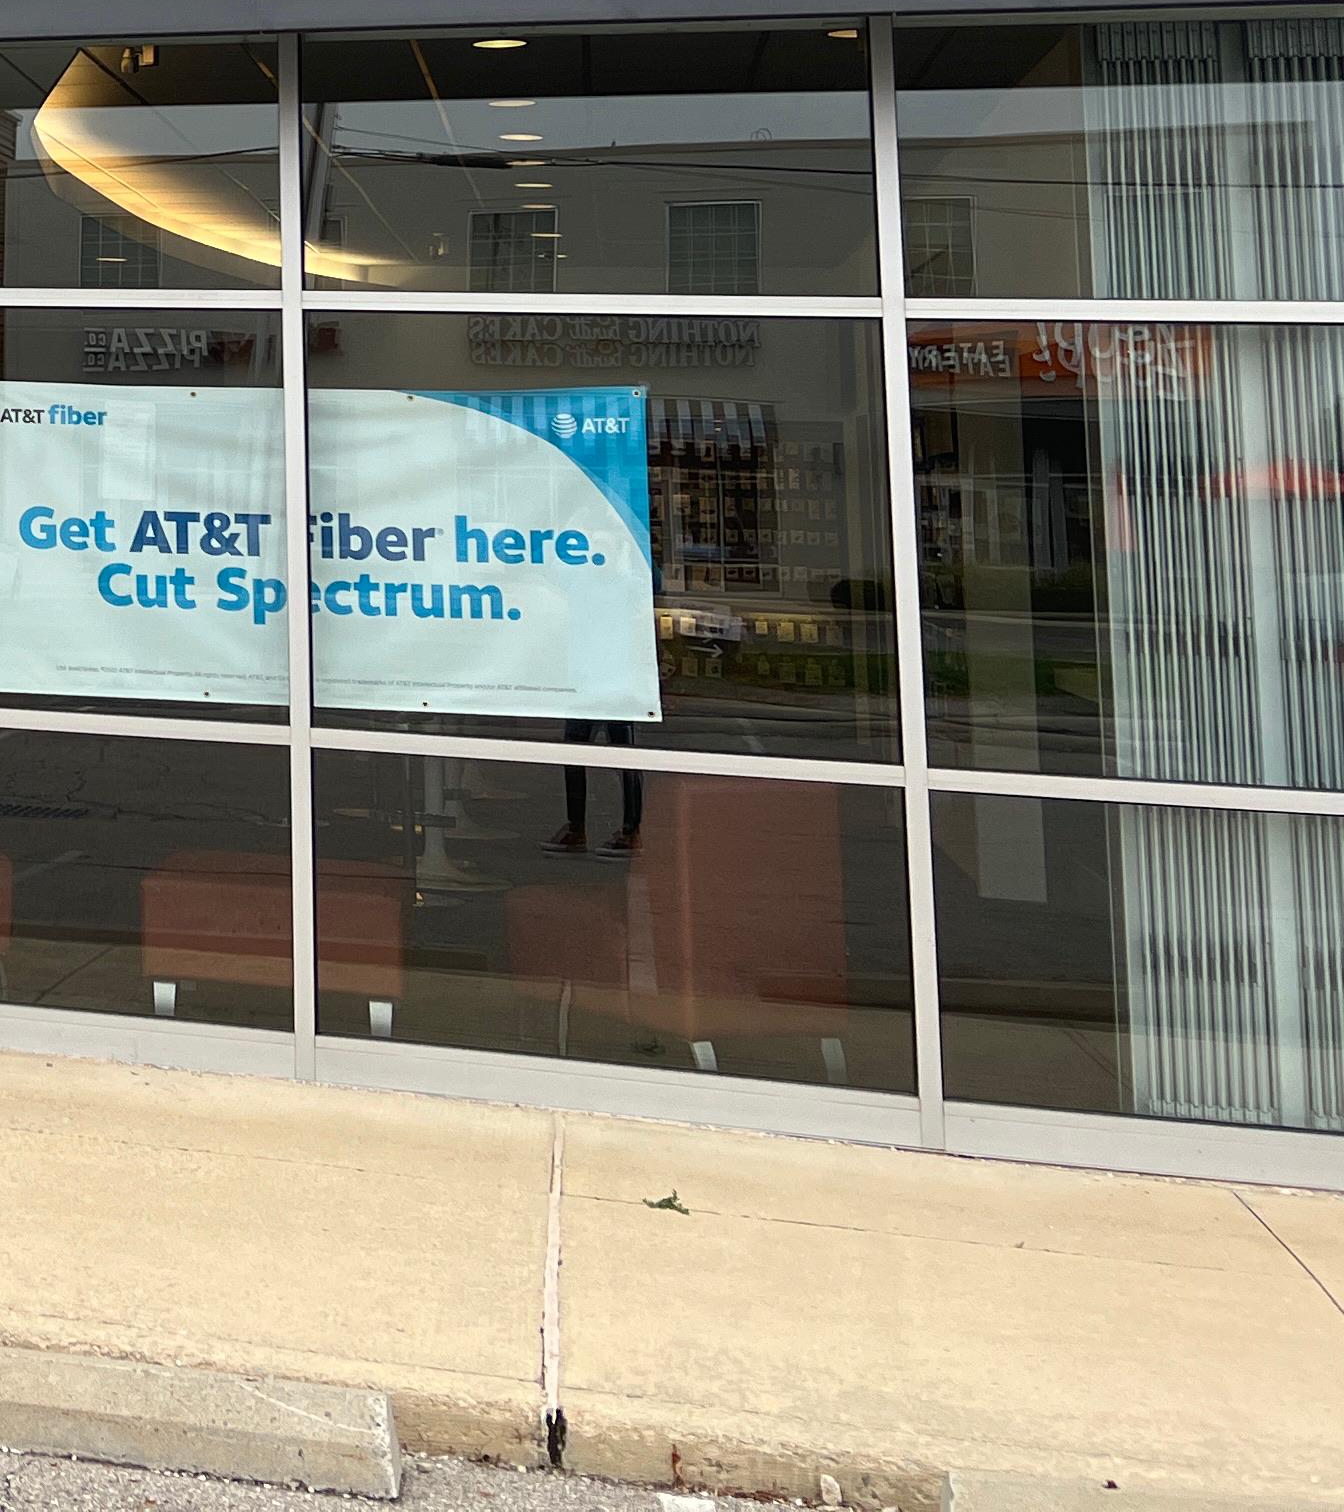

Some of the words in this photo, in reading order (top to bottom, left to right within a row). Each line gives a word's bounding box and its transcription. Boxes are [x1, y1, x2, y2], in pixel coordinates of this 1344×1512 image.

[0, 408, 45, 424] AT&T
[48, 404, 108, 426] fiber
[581, 417, 630, 434] AT&T
[18, 505, 117, 553] Get
[129, 510, 272, 558] AT&T
[308, 511, 436, 562] iber
[454, 514, 606, 567] here.
[97, 562, 197, 610] Cut
